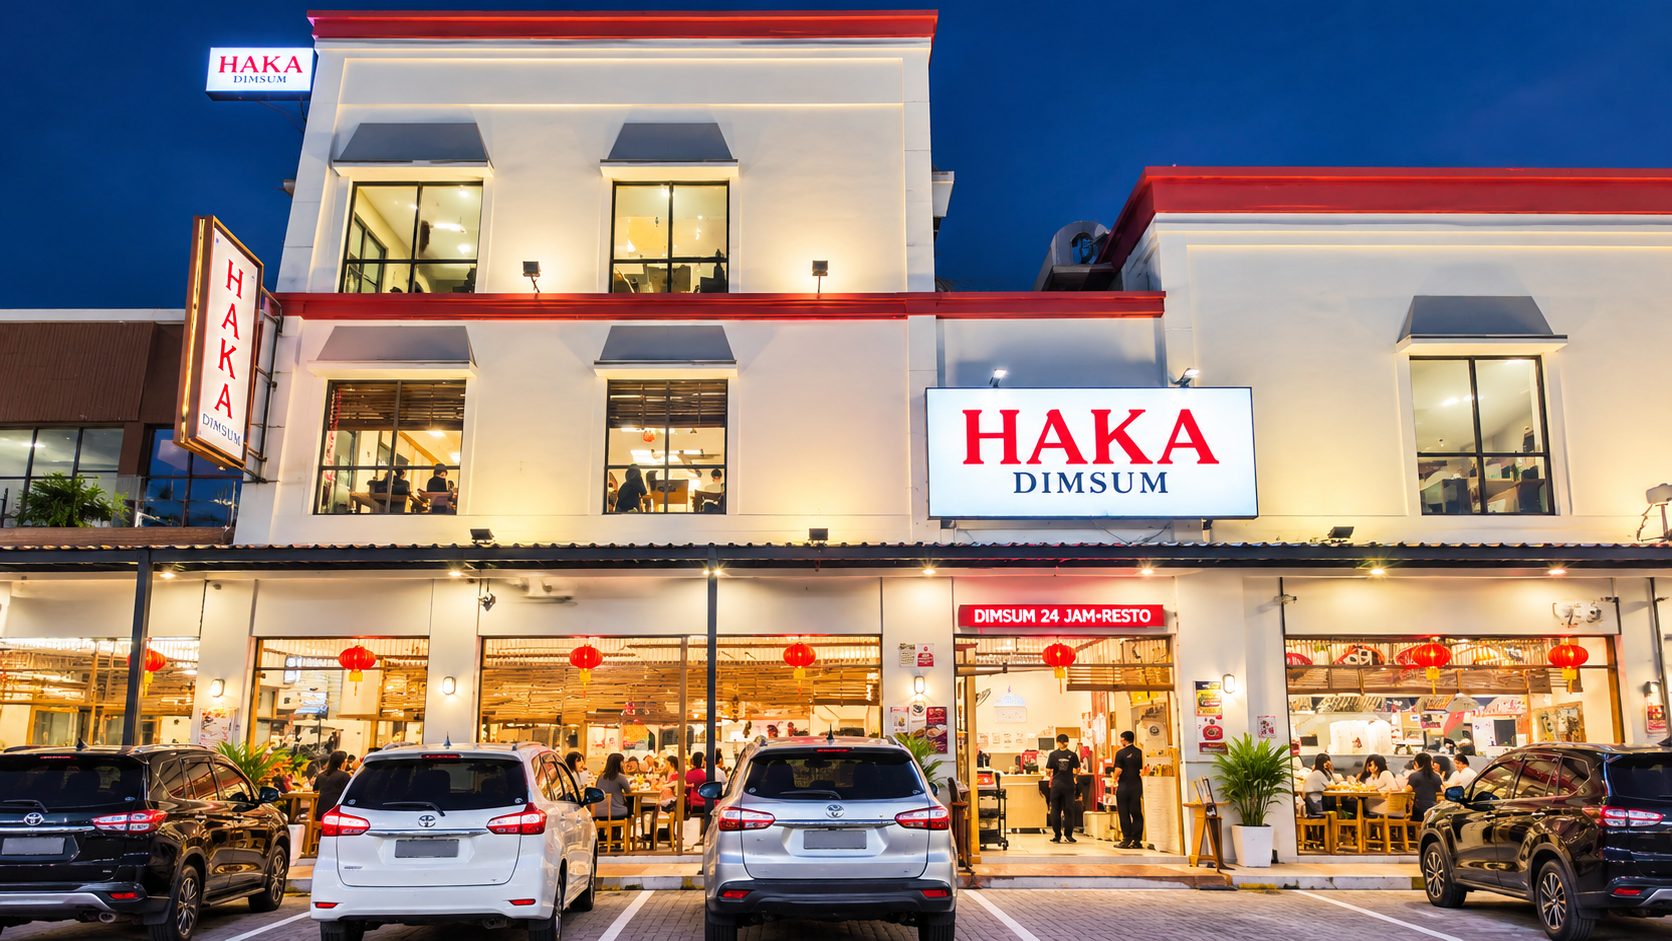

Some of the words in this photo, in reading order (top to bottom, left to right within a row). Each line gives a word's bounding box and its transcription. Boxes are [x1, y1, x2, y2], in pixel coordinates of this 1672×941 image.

[218, 55, 303, 73] HAKA
[233, 75, 286, 83] DIMSUM
[214, 258, 244, 420] HAKA
[202, 413, 241, 447] DIMSUM
[962, 408, 1220, 465] HAKA
[1013, 471, 1169, 494] DIMSUM
[974, 608, 1036, 623] DIMSUM
[1040, 608, 1060, 623] 24
